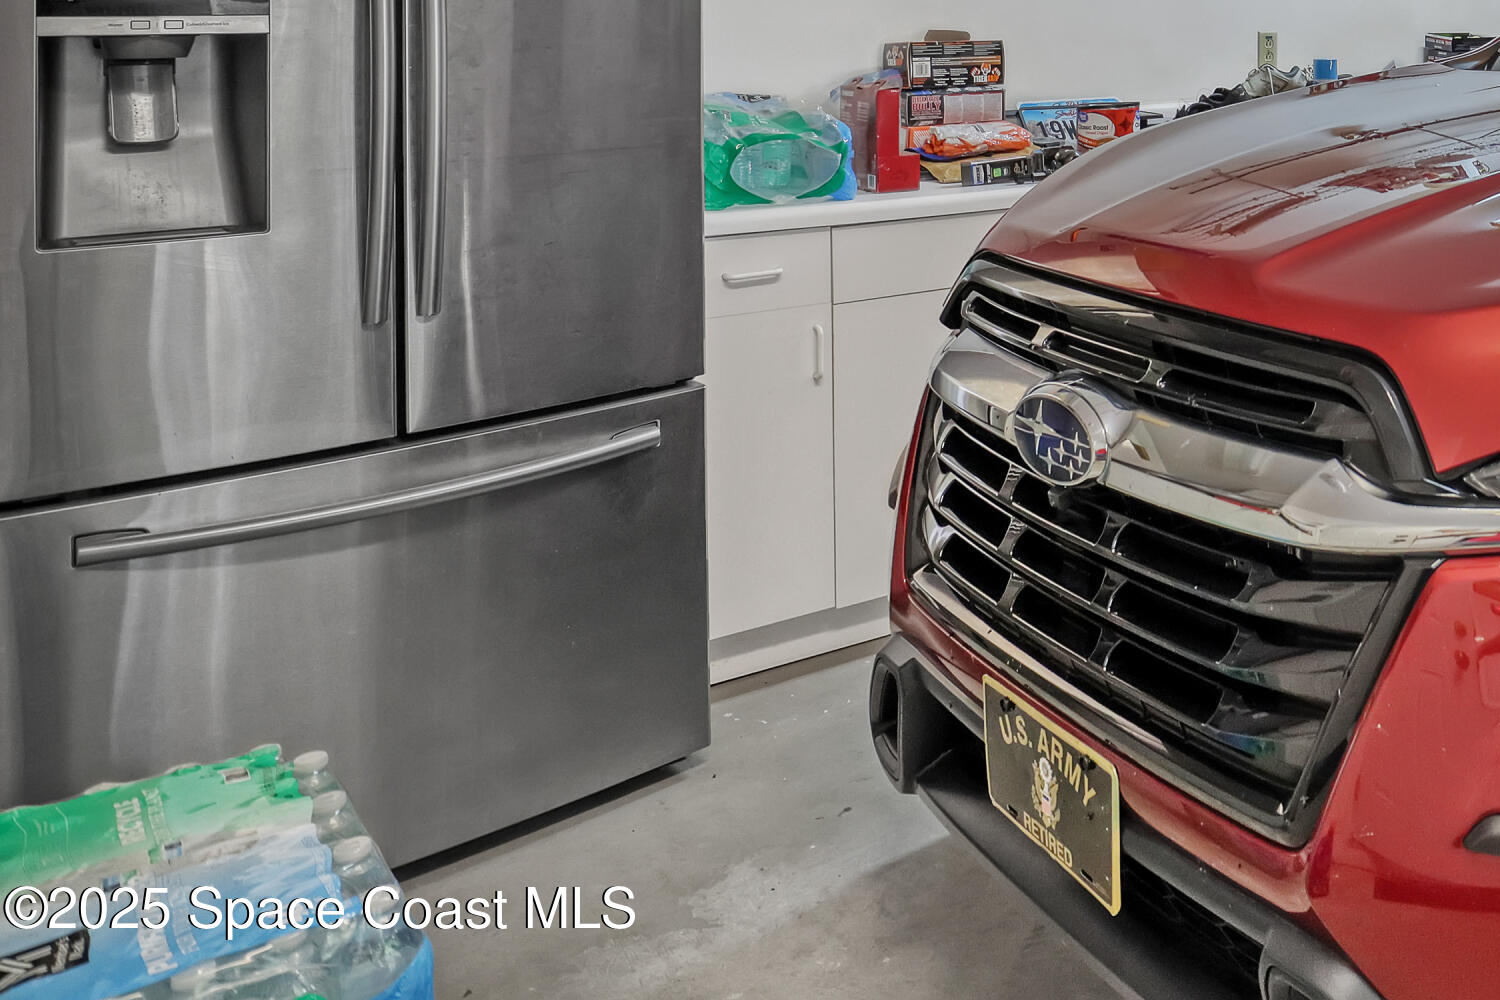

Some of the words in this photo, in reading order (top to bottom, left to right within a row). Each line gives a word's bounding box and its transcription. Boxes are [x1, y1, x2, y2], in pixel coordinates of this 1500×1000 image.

[998, 714, 1033, 748] U.S.
[1037, 727, 1097, 807] ARMY
[1023, 811, 1073, 868] RETIRED
